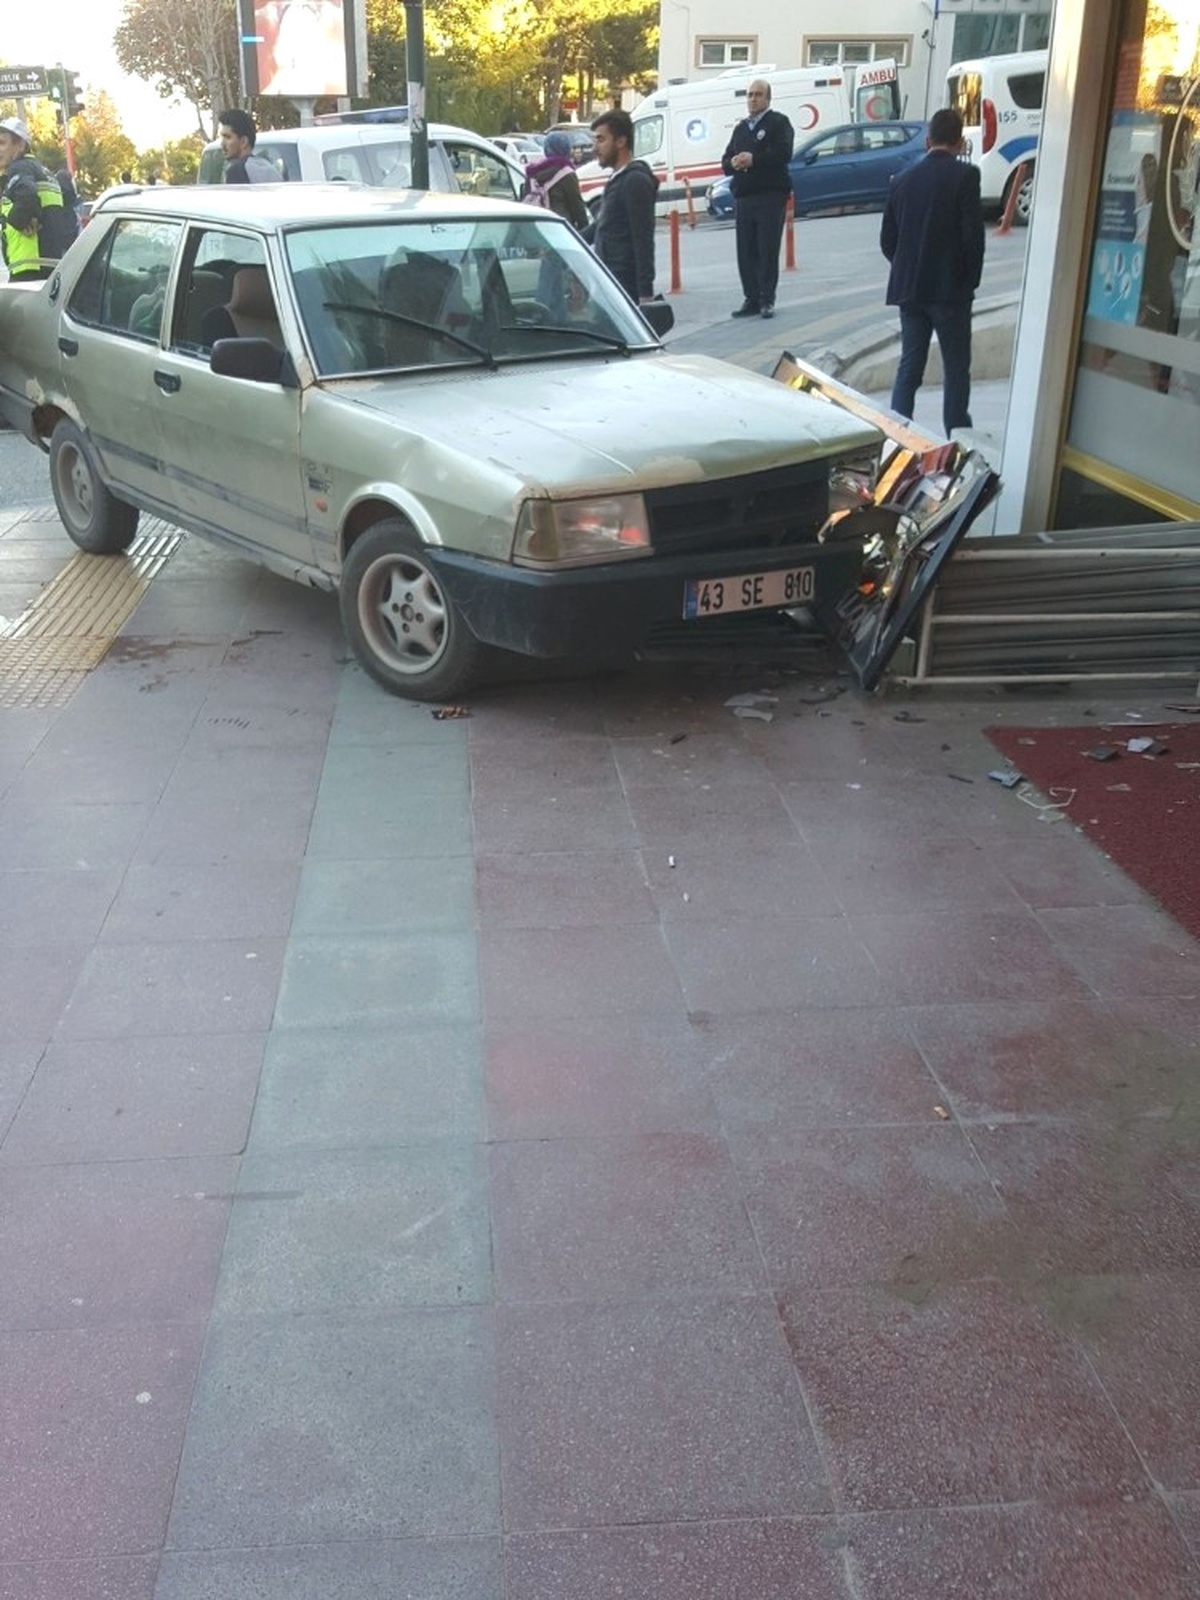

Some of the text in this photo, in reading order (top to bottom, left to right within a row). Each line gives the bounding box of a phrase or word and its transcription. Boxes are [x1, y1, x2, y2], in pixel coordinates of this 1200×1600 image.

[860, 67, 896, 86] AMBU
[998, 109, 1018, 123] 155
[700, 570, 812, 612] 43 SE 810
